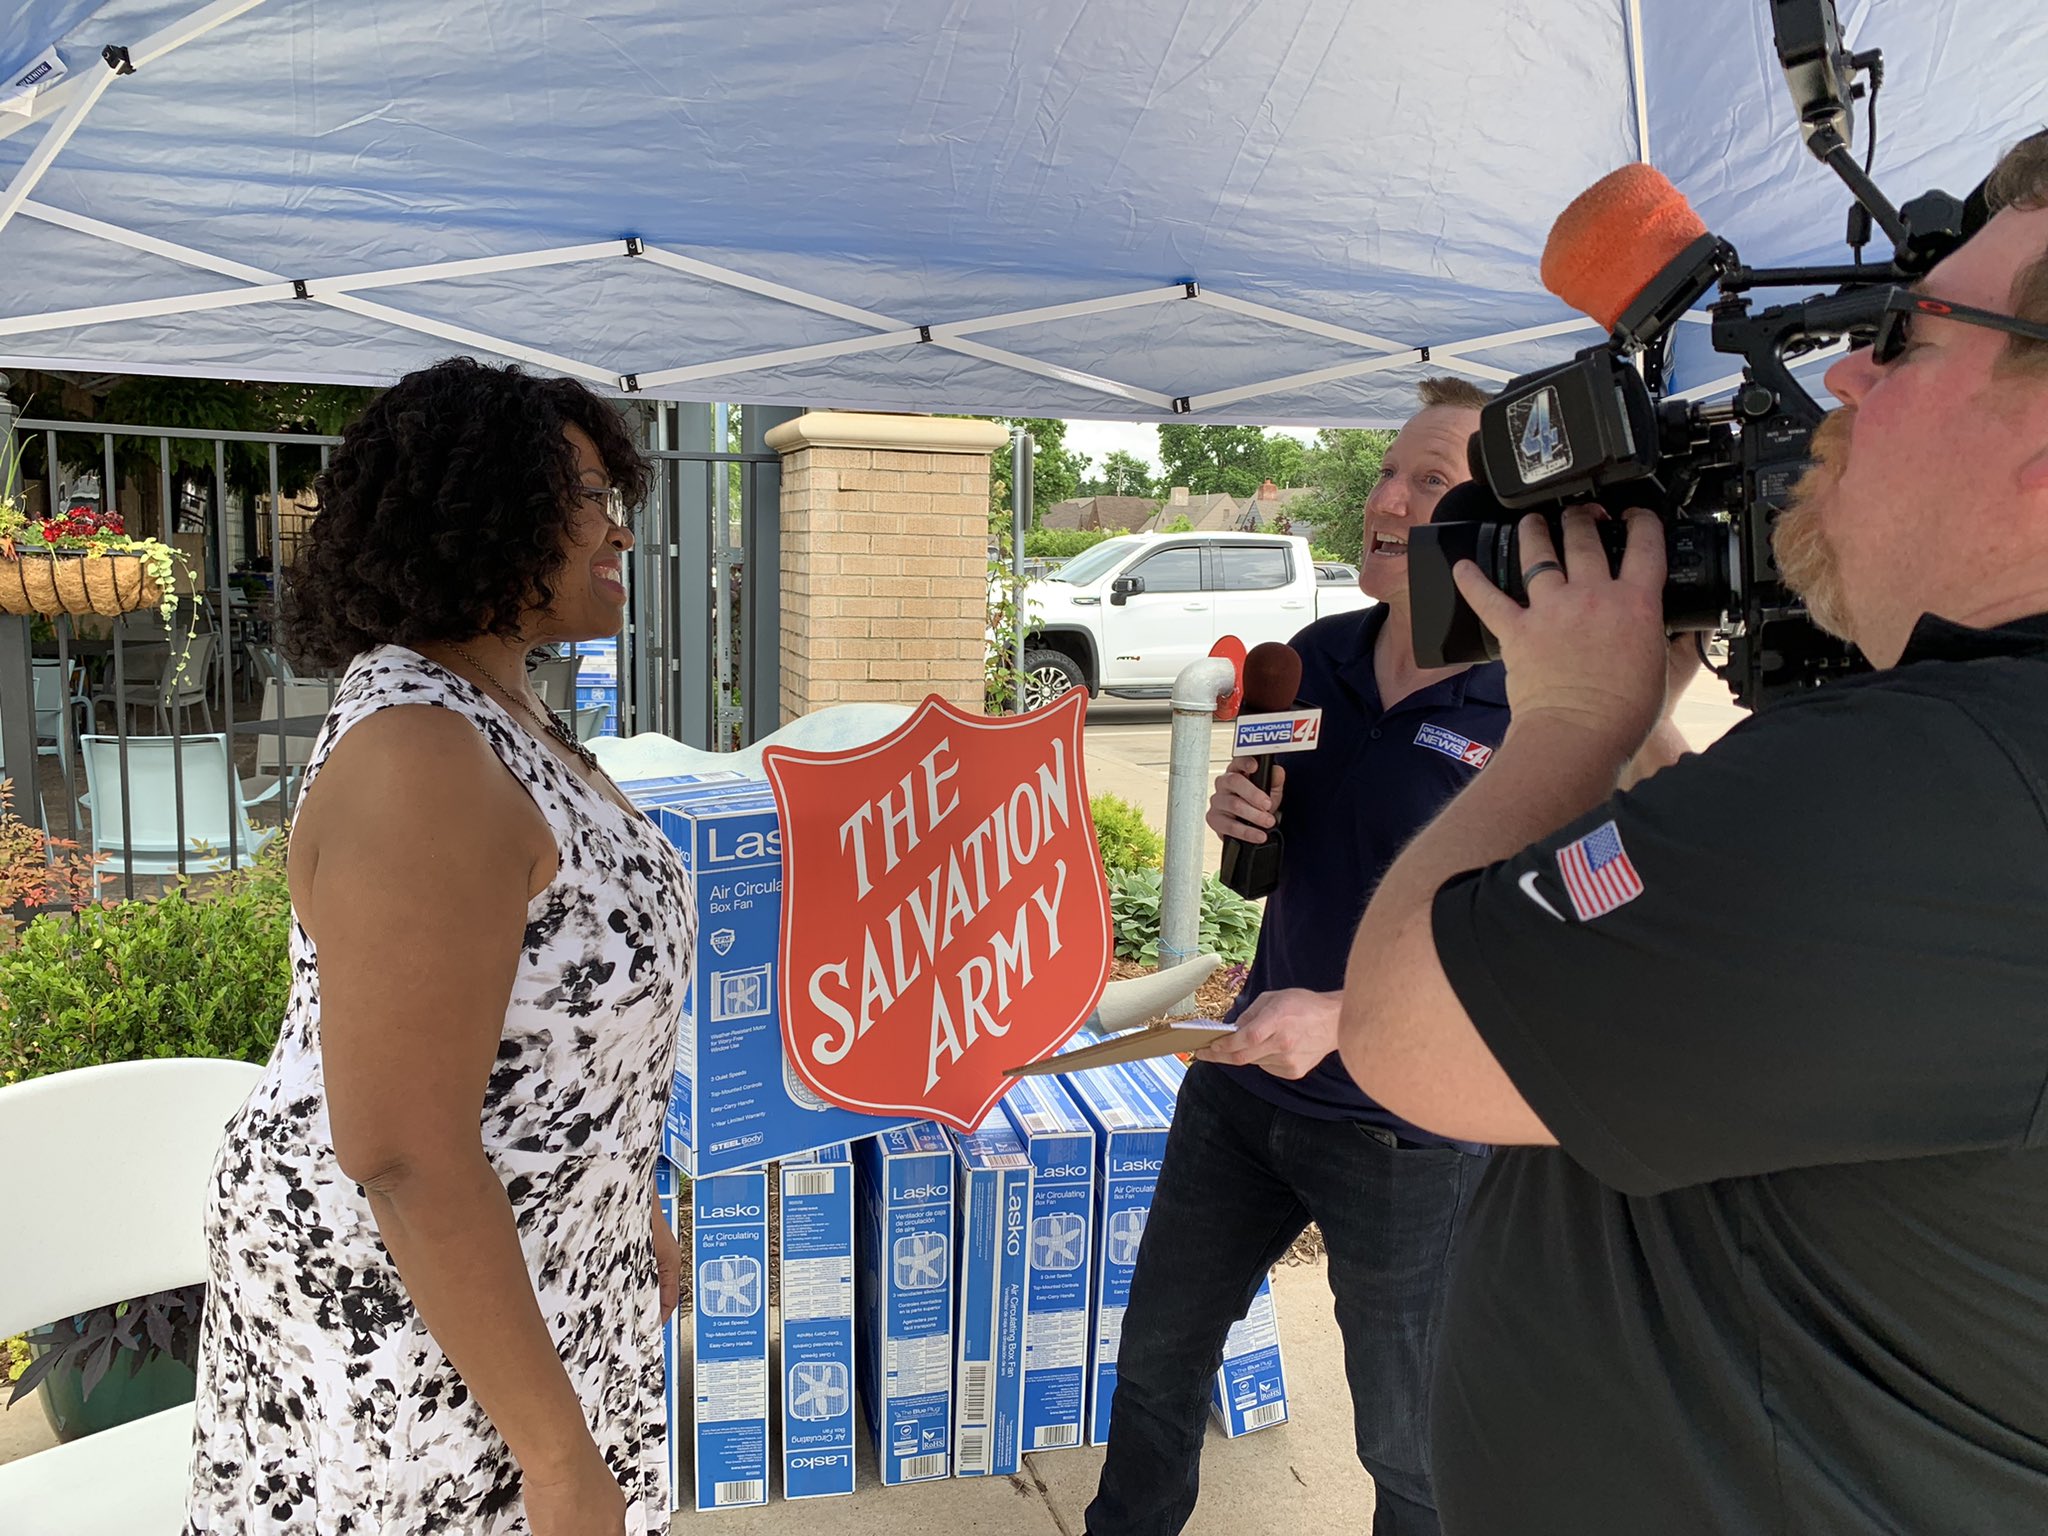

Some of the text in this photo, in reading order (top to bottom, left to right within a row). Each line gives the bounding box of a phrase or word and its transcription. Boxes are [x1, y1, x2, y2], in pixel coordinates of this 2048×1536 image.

[1520, 390, 1558, 464] 4
[1239, 718, 1318, 744] NEWS 4
[1240, 722, 1292, 732] OKLAHOMA'S
[1422, 726, 1467, 746] OKLAHOMA'S
[1419, 732, 1491, 767] NEWS 4
[838, 736, 960, 902] THE
[710, 878, 782, 900] Air Circula
[710, 900, 753, 914] Box Fan
[808, 737, 1070, 1066] SALVATION
[922, 858, 1067, 1098] ARMY
[729, 1070, 747, 1080] Speeds
[710, 1135, 762, 1152] STEEL Body
[1034, 1164, 1087, 1178] Lasko
[1114, 1158, 1163, 1172] Lasko
[893, 1184, 948, 1200] Lasko
[1046, 1190, 1086, 1199] Circulating
[700, 1204, 760, 1219] Lasko
[895, 1212, 924, 1220] Ventilador
[1007, 1182, 1026, 1255] Lasko
[702, 1231, 759, 1242] Air Circulating
[1007, 1284, 1020, 1378] Air Circulating Box Fan
[792, 1434, 834, 1444] Circulating
[924, 1440, 944, 1448] RoHS
[790, 1454, 848, 1470] Lasko
